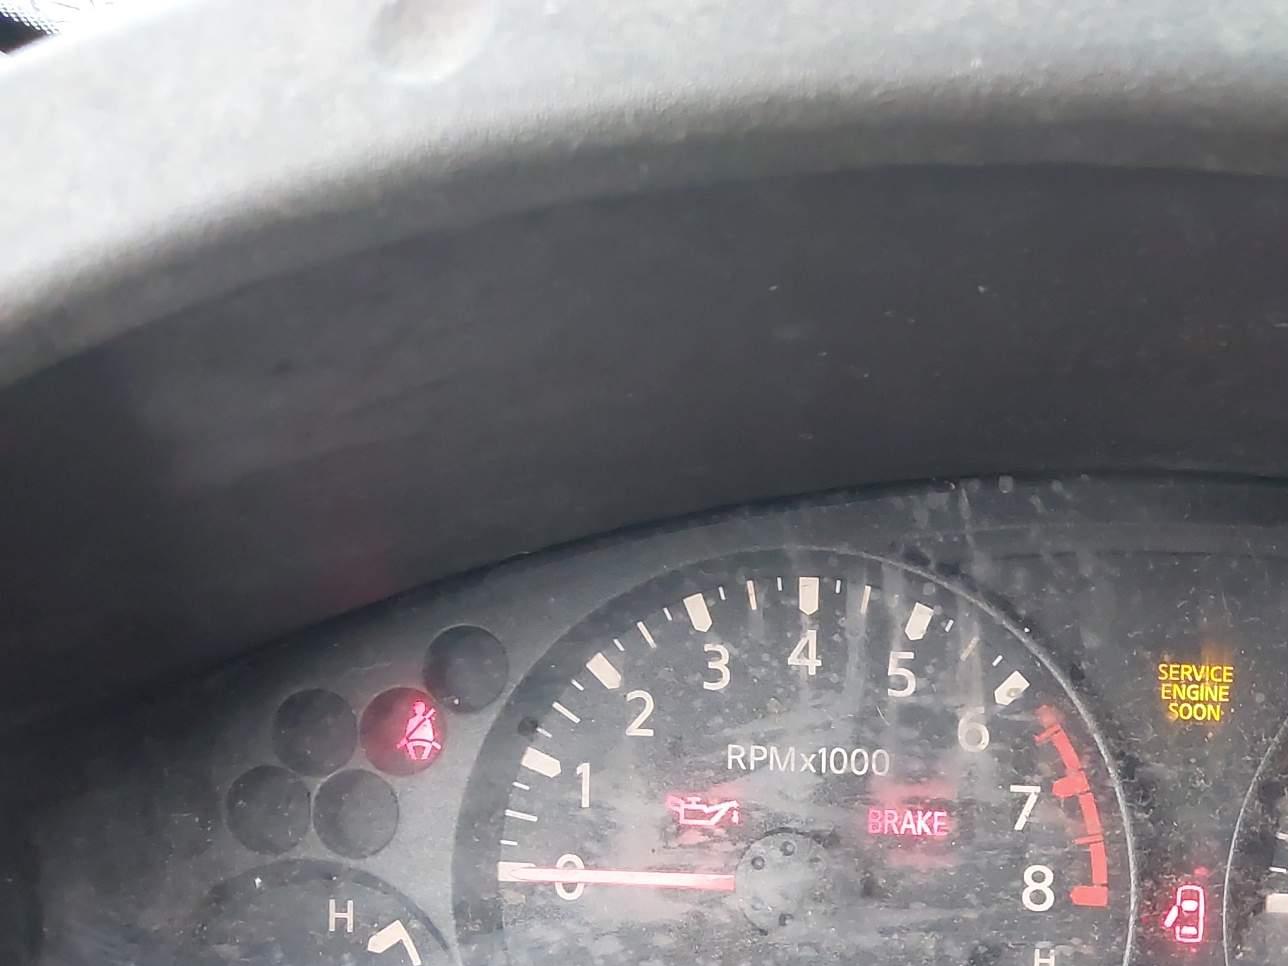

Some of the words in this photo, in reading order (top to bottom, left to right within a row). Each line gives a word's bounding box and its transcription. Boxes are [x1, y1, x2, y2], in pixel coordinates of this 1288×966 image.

[703, 644, 732, 690] 3
[787, 630, 822, 675] 4
[887, 651, 917, 697] 5
[1158, 663, 1234, 683] SERVICE
[625, 690, 655, 737] 2
[1161, 683, 1230, 702] ENGINE
[1168, 702, 1221, 721] SOON
[957, 706, 990, 752] 6
[576, 762, 591, 808] 1
[1010, 785, 1041, 831] 7
[868, 808, 948, 836] BRAKE
[553, 853, 586, 900] 0
[1021, 865, 1055, 912] 8
[329, 900, 354, 932] H
